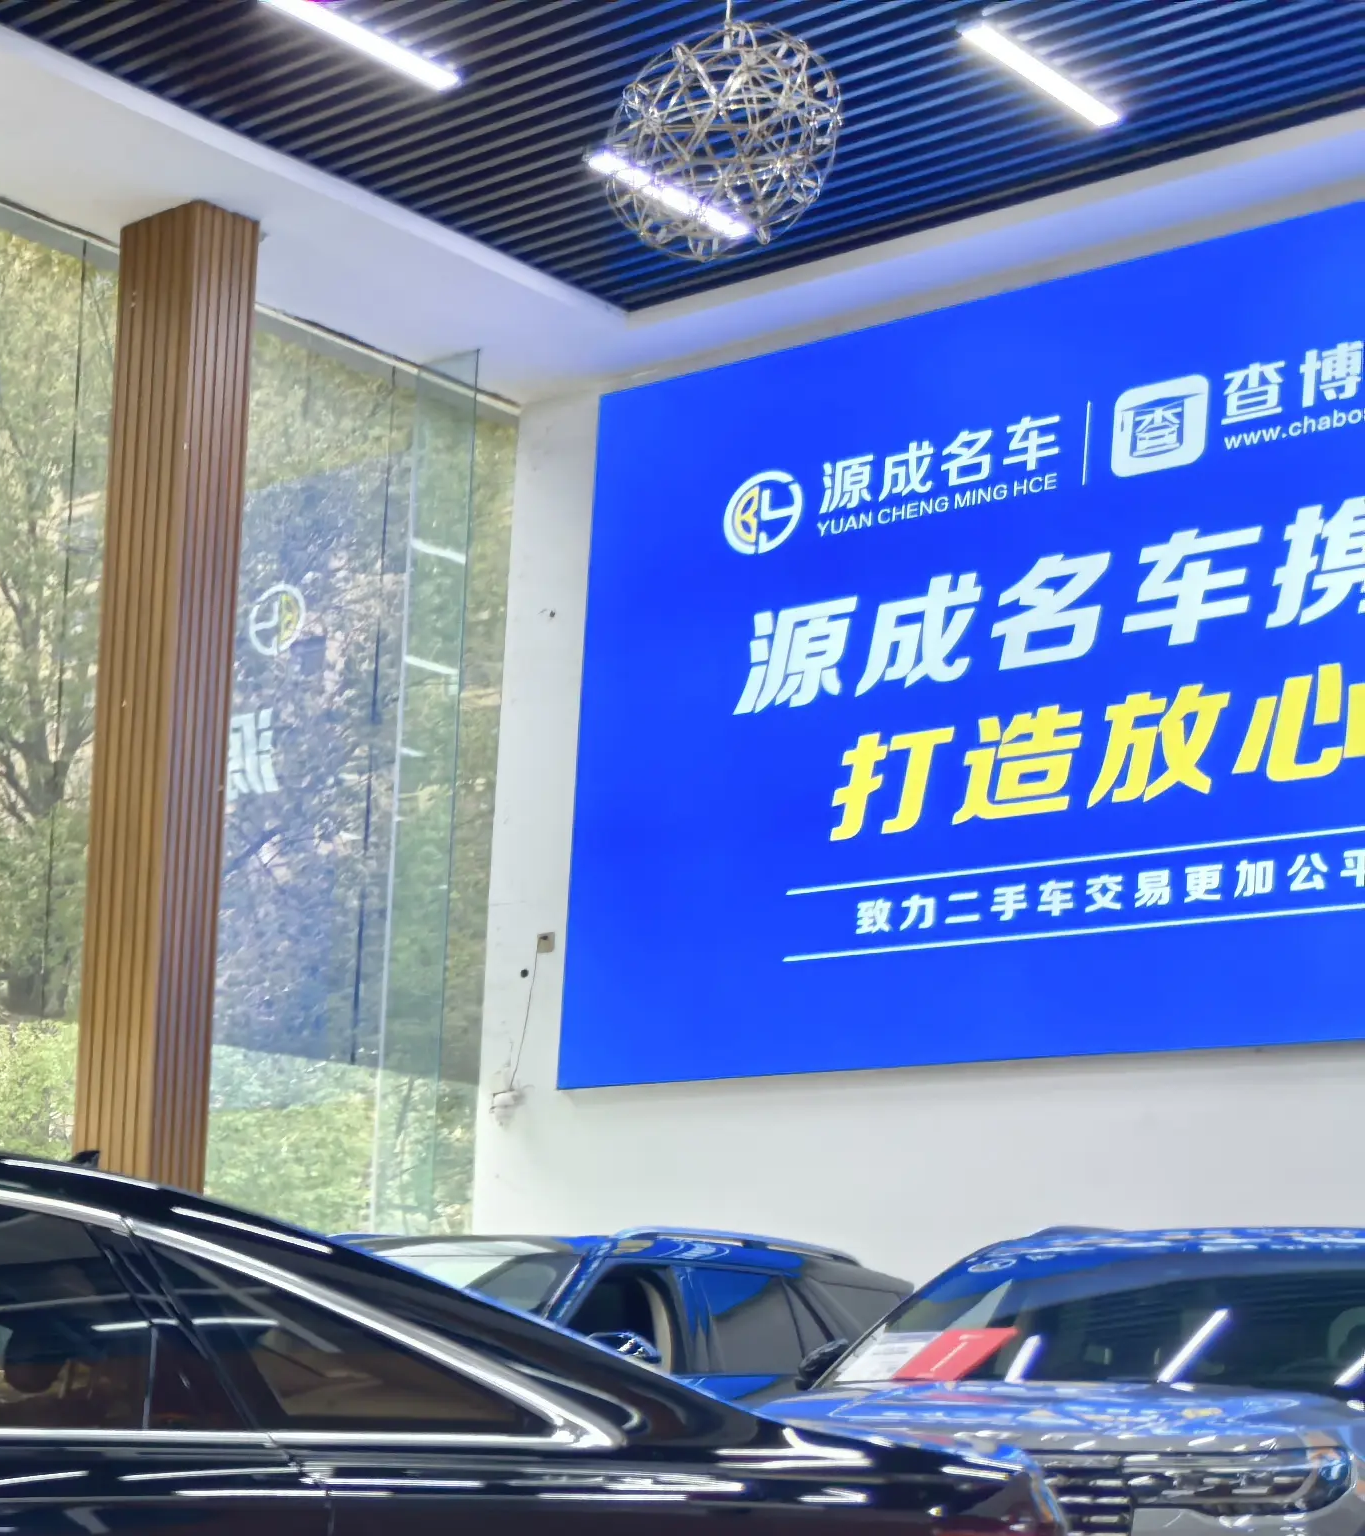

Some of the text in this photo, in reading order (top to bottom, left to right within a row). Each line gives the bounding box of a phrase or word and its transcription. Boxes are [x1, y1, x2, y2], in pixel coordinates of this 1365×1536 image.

[819, 414, 1061, 515] 源成名车
[1223, 408, 1365, 451] www.chabo
[817, 472, 1058, 538] YUAN CHENG MING HCE
[829, 662, 1365, 842] 打造放心
